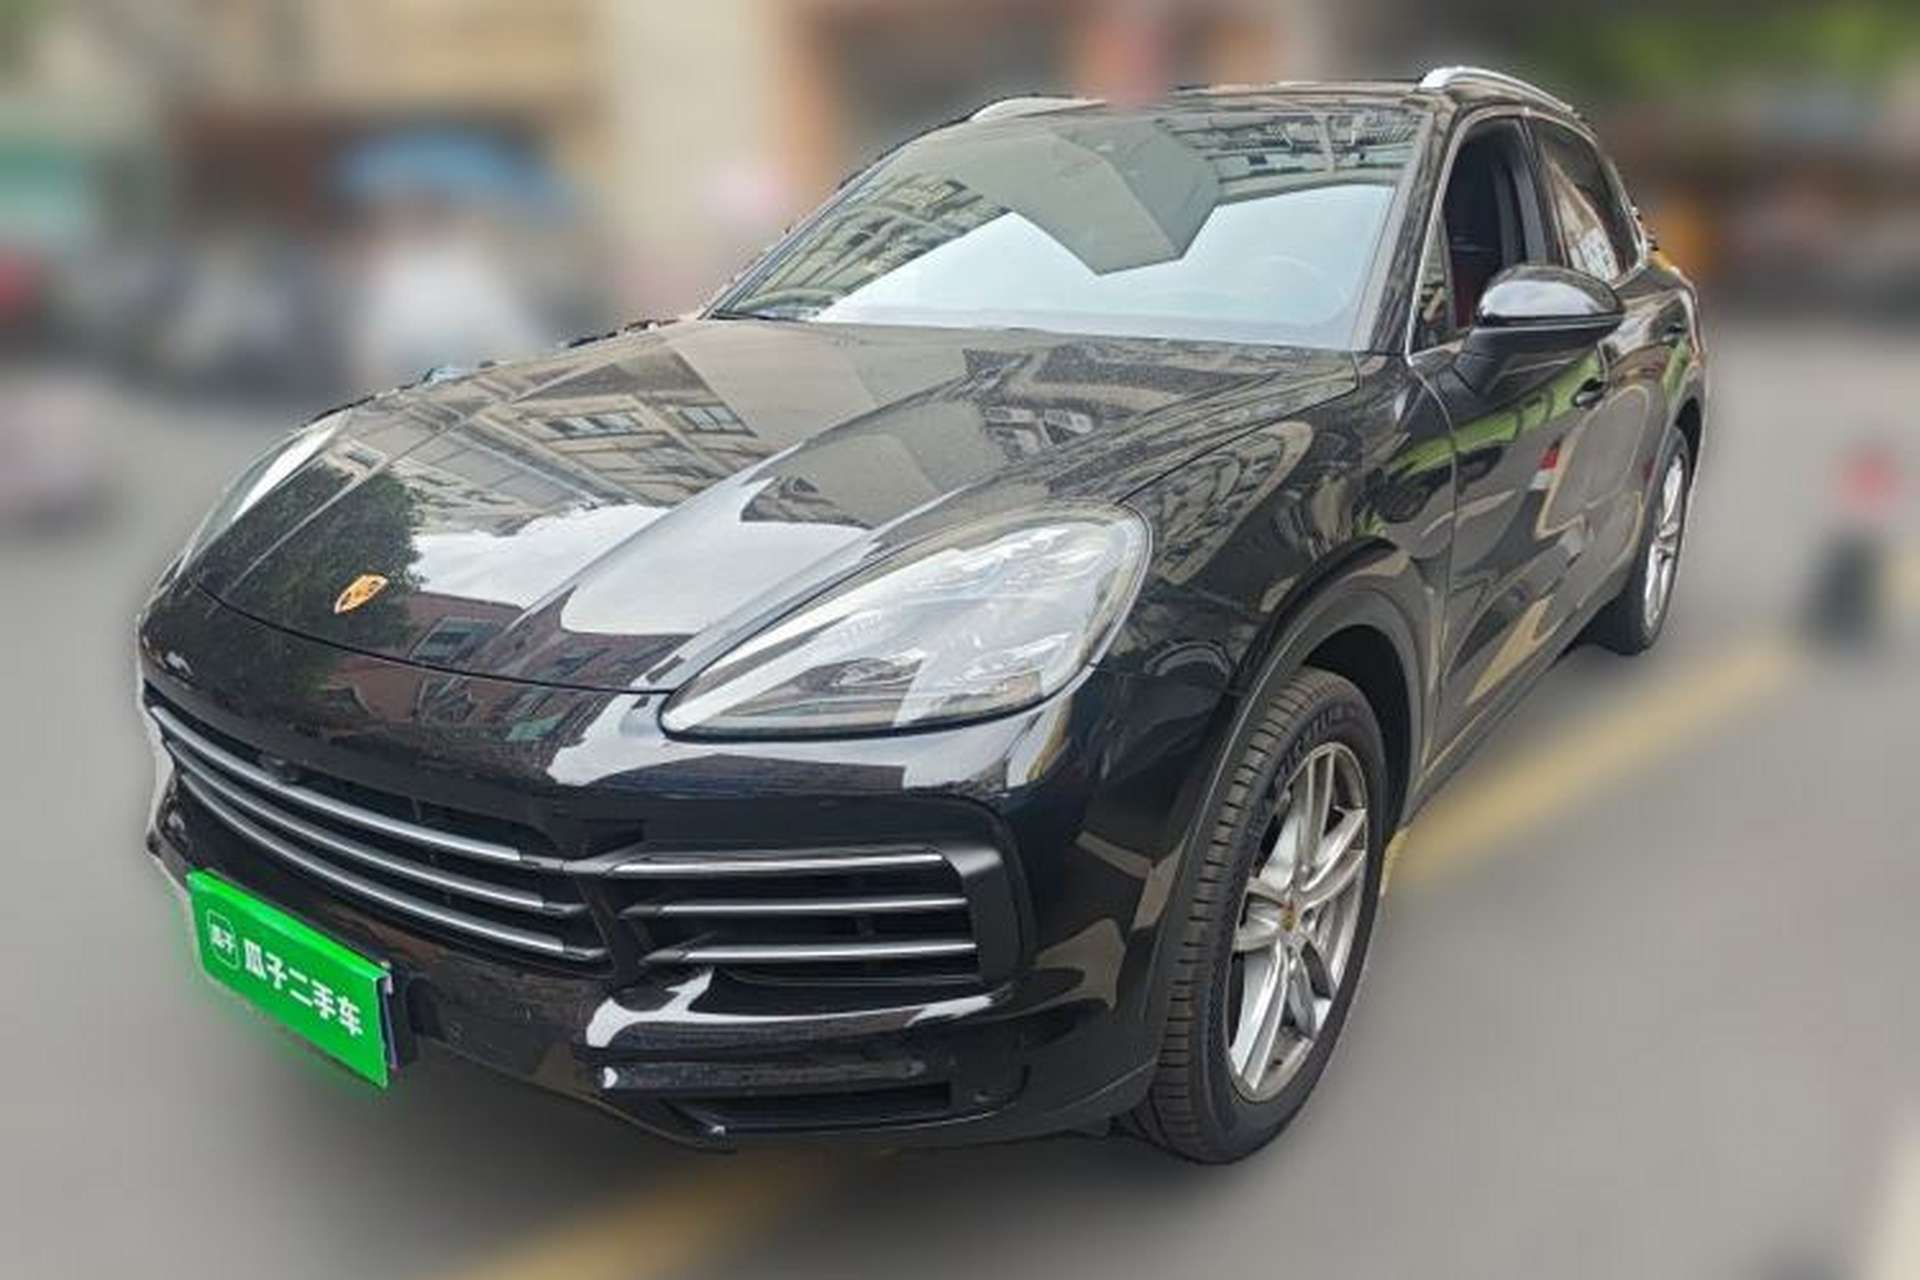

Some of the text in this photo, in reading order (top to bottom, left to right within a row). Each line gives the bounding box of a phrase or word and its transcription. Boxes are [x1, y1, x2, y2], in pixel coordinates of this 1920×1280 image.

[243, 938, 363, 1036] 瓜子二手车
